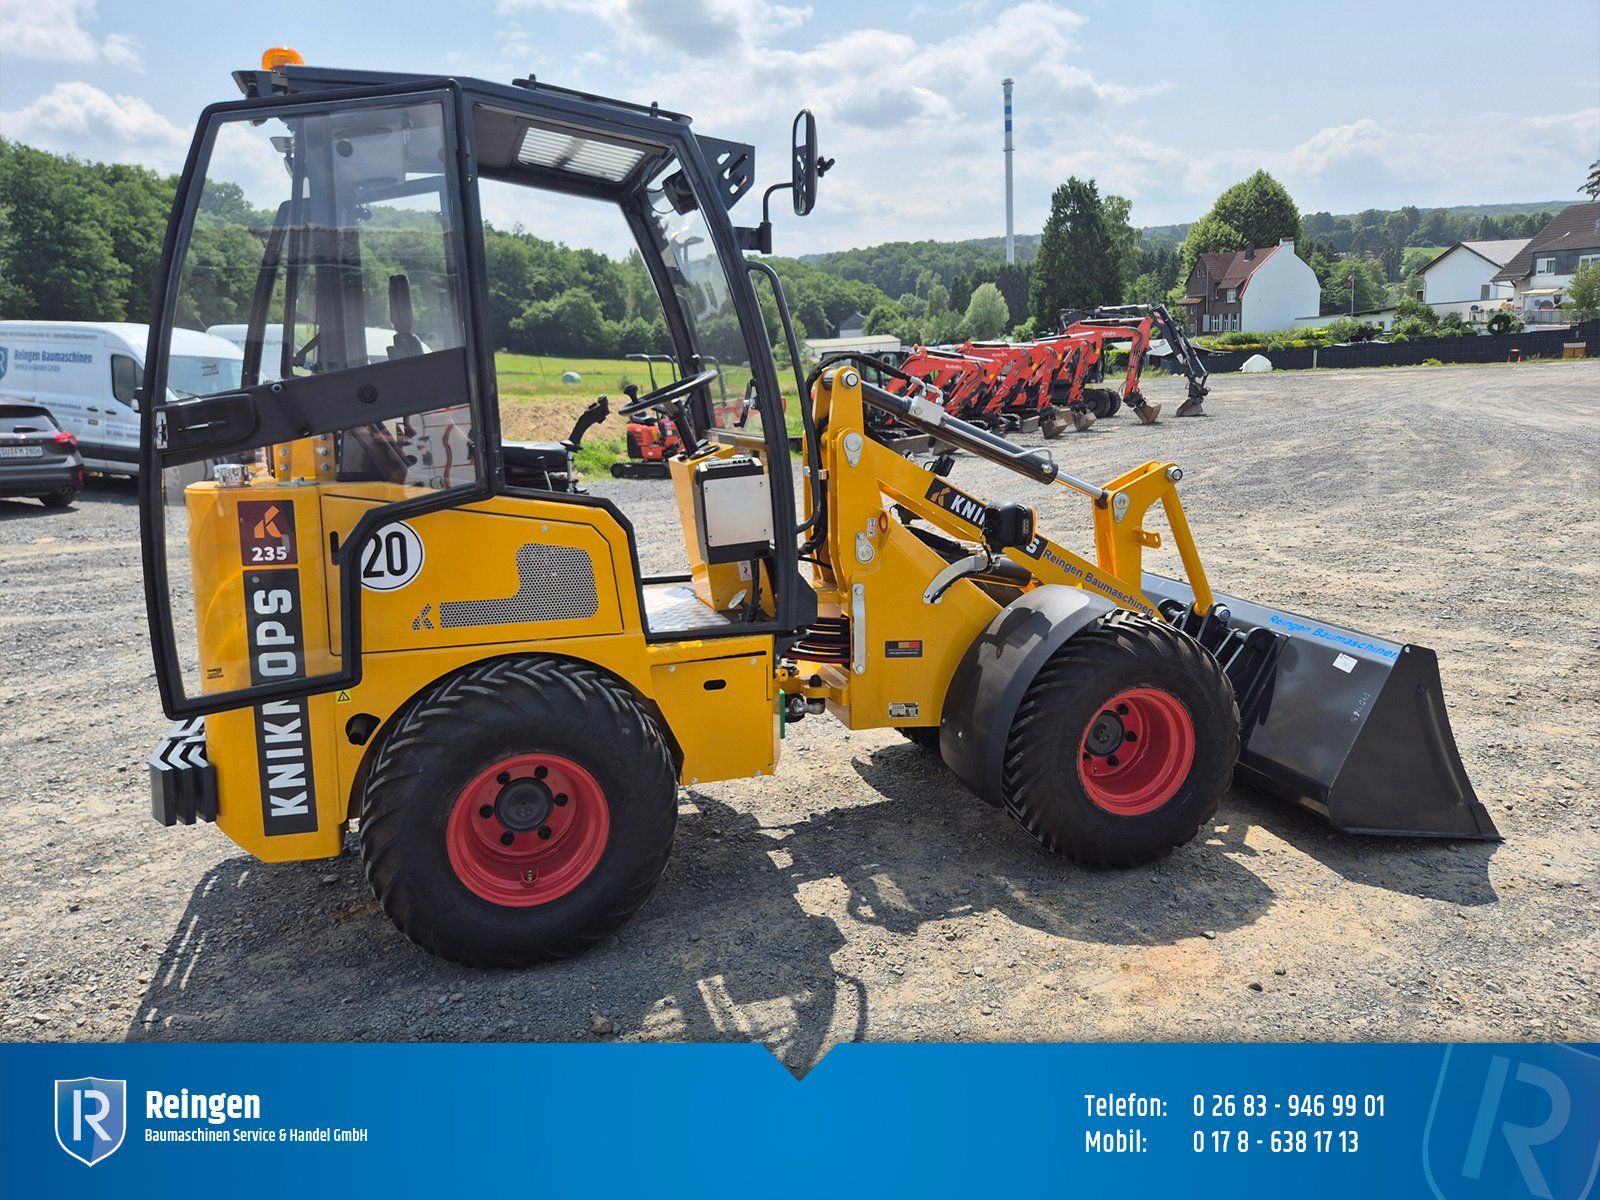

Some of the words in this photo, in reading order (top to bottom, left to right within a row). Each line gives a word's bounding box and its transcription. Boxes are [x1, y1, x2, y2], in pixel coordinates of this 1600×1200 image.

[15, 349, 40, 362] Reingen
[42, 350, 93, 363] Baumaschinen
[252, 546, 287, 561] 235
[363, 531, 408, 578] 20
[1043, 549, 1083, 578] Reingen
[1085, 572, 1154, 615] Baumaschinen
[1269, 615, 1311, 632] Reingen
